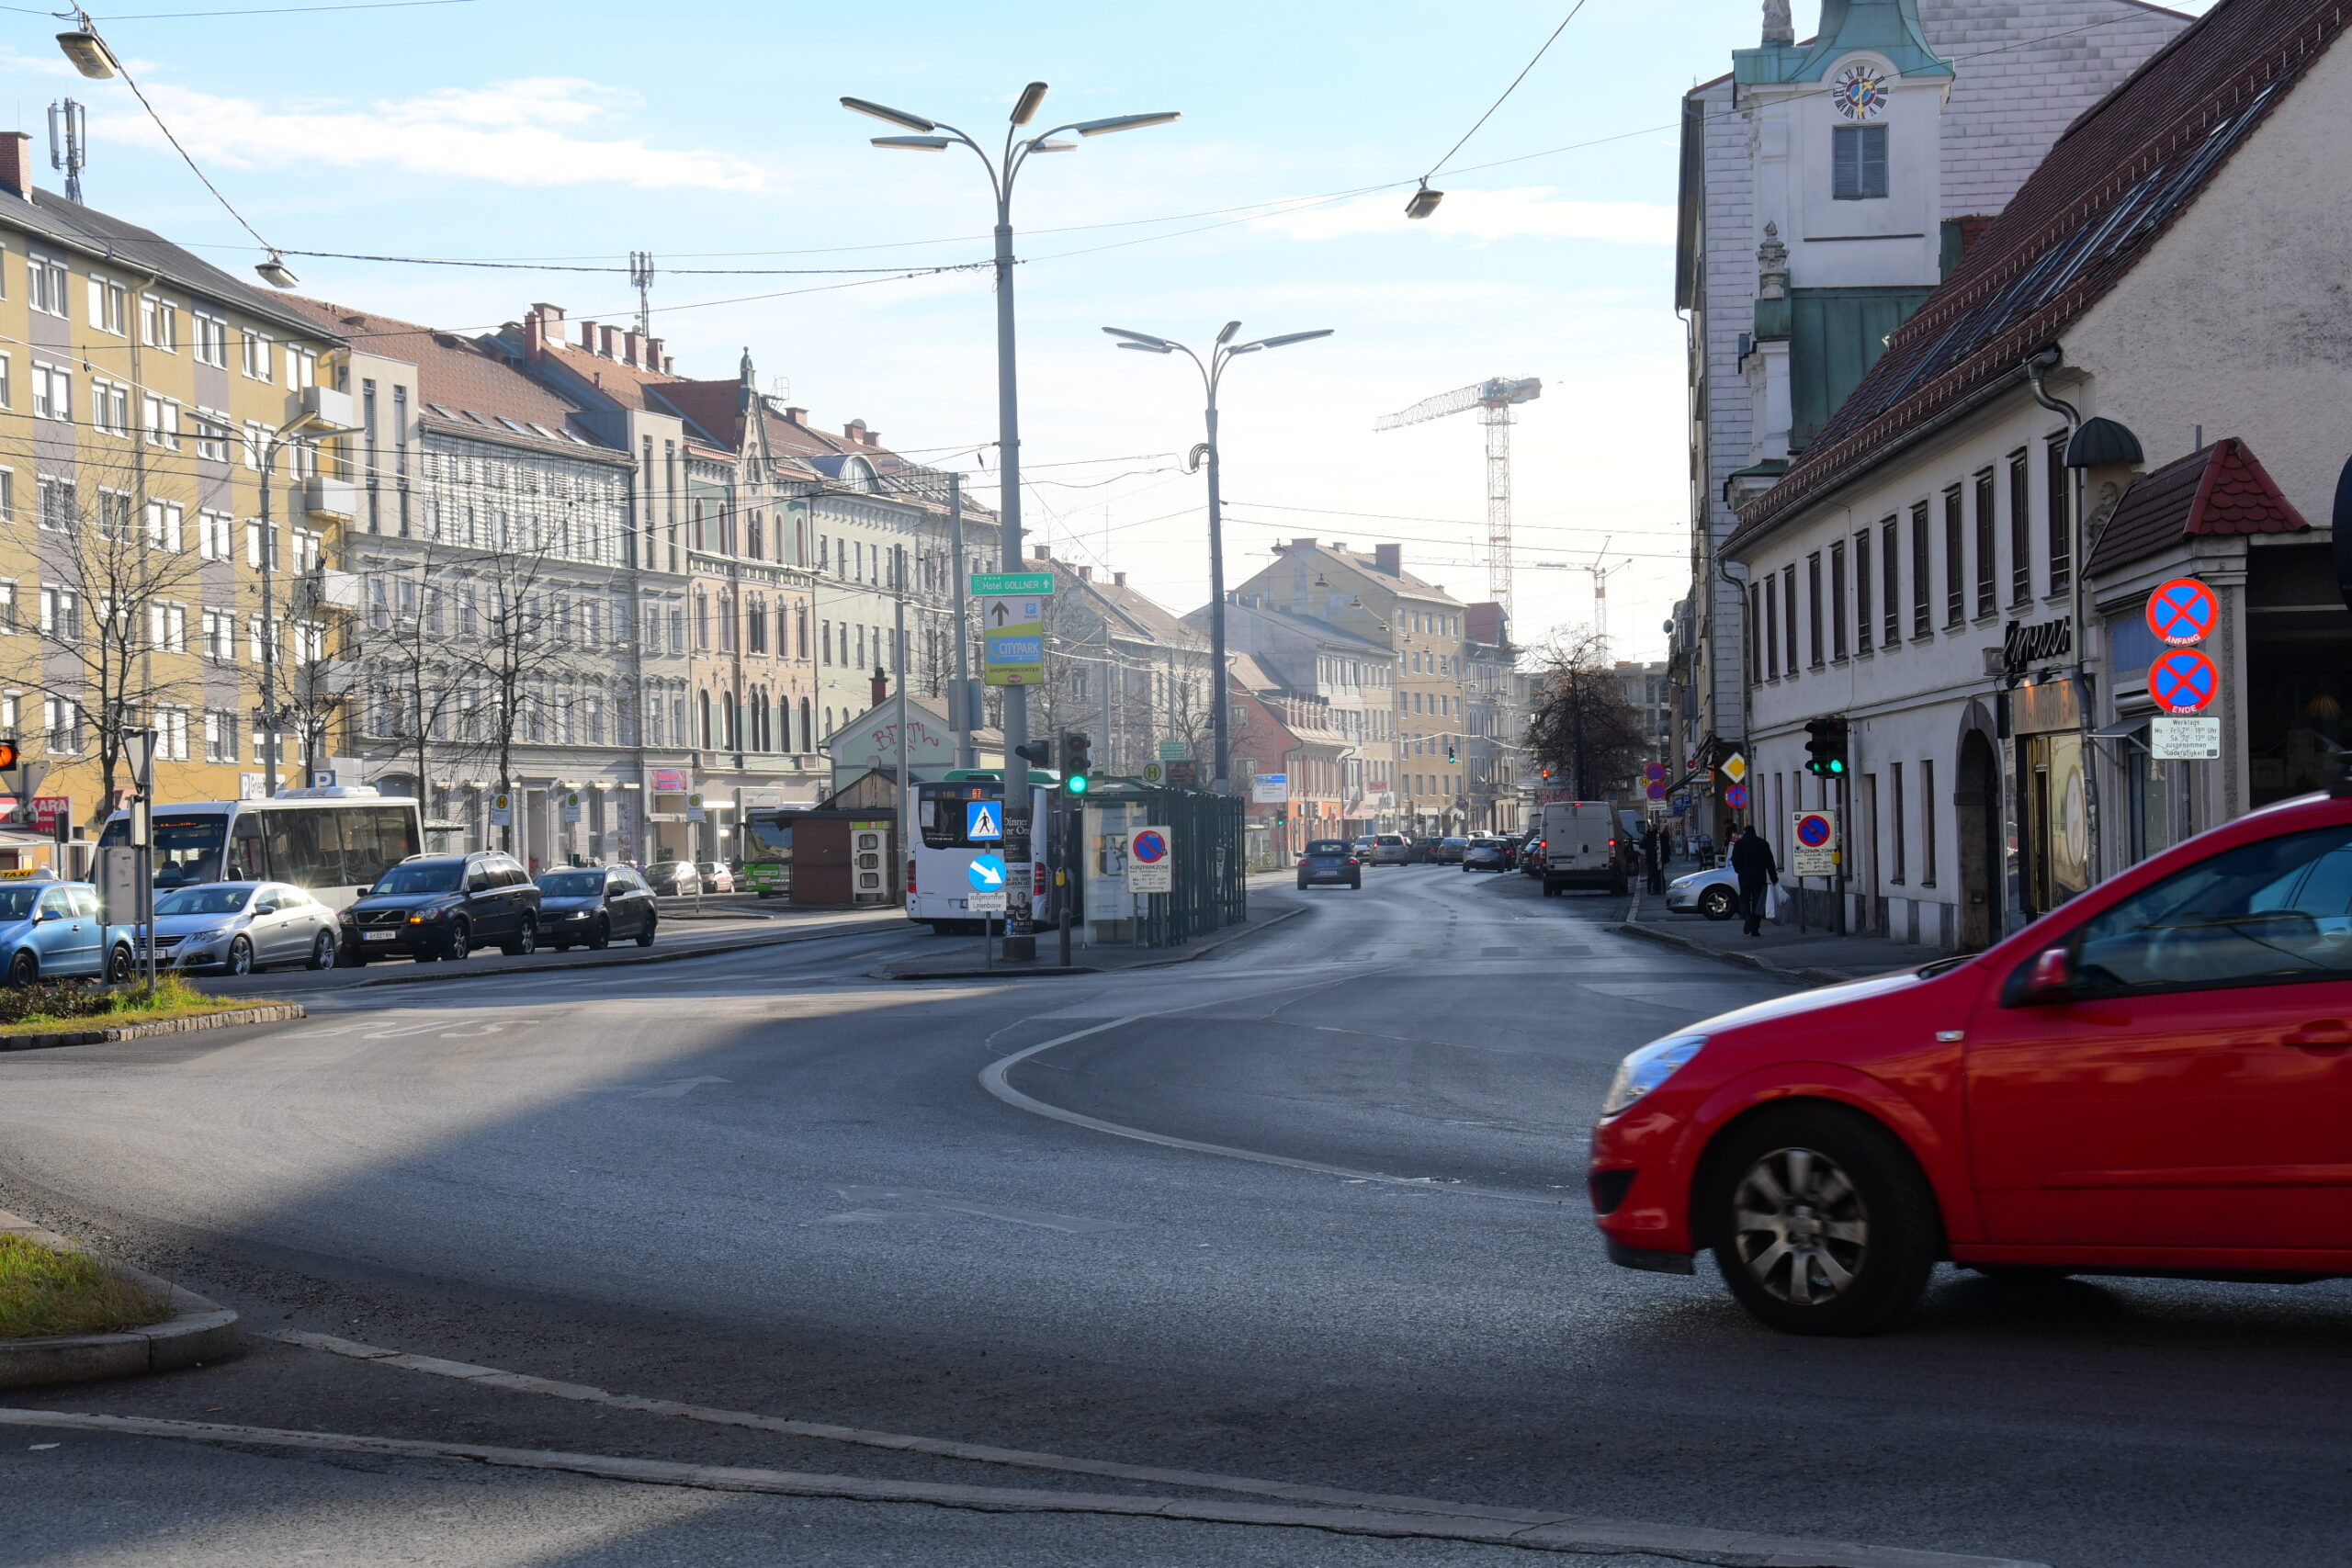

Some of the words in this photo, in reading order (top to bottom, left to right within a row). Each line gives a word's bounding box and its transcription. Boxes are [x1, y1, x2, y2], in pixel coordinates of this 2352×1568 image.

[983, 581, 1002, 591] Hotel
[1004, 581, 1039, 590] GOLLNER
[2165, 634, 2201, 645] ANFANG
[999, 642, 1039, 655] CITYPARK
[2172, 704, 2197, 714] ENDE
[2165, 742, 2207, 750] ausgenommen
[314, 773, 332, 787] P
